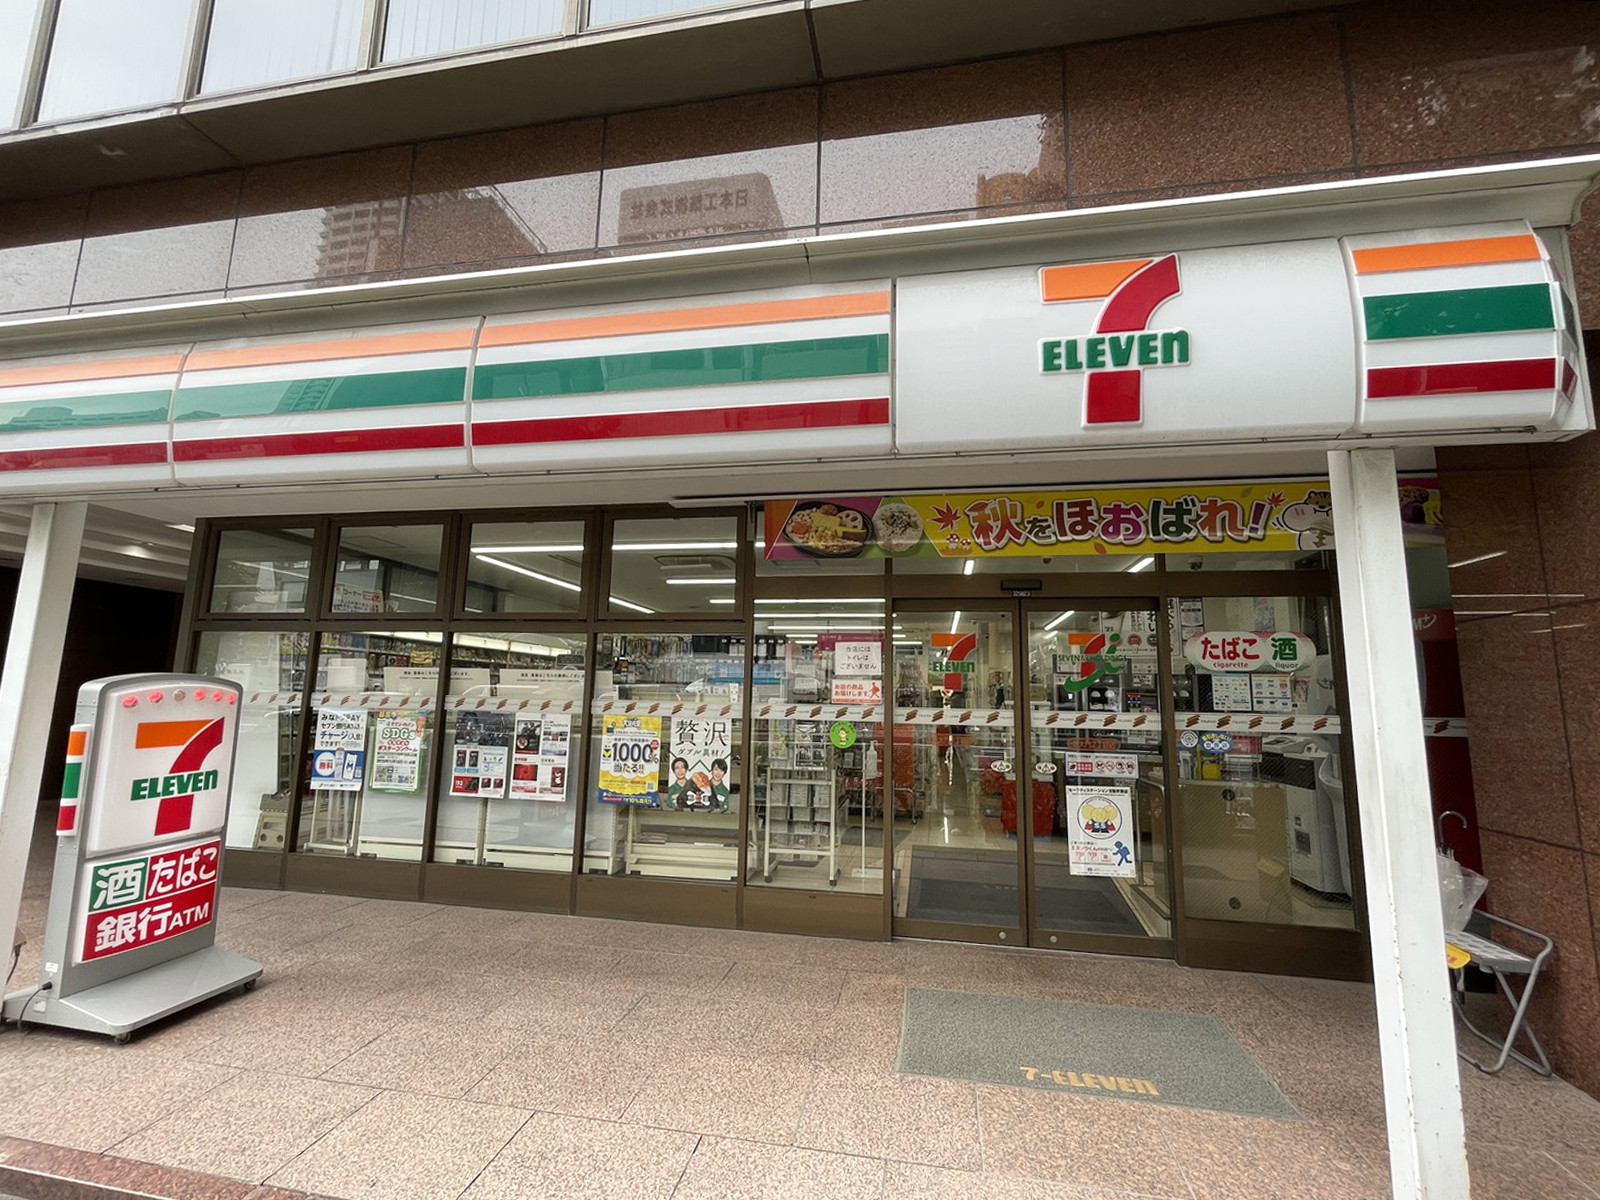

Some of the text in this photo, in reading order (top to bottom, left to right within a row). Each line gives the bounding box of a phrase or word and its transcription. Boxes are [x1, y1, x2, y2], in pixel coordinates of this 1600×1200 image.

[1042, 330, 1189, 372] ELEVEn
[966, 496, 1267, 549] 秋をほおばれ!
[1201, 637, 1260, 660] たばこ
[1271, 638, 1297, 661] 酒
[1212, 661, 1249, 669] cigarette
[382, 728, 416, 740] SDGs
[675, 720, 727, 746] 贅沢
[130, 769, 218, 801] ELEVEn
[93, 862, 146, 910] 酒
[148, 848, 217, 897] たばこ
